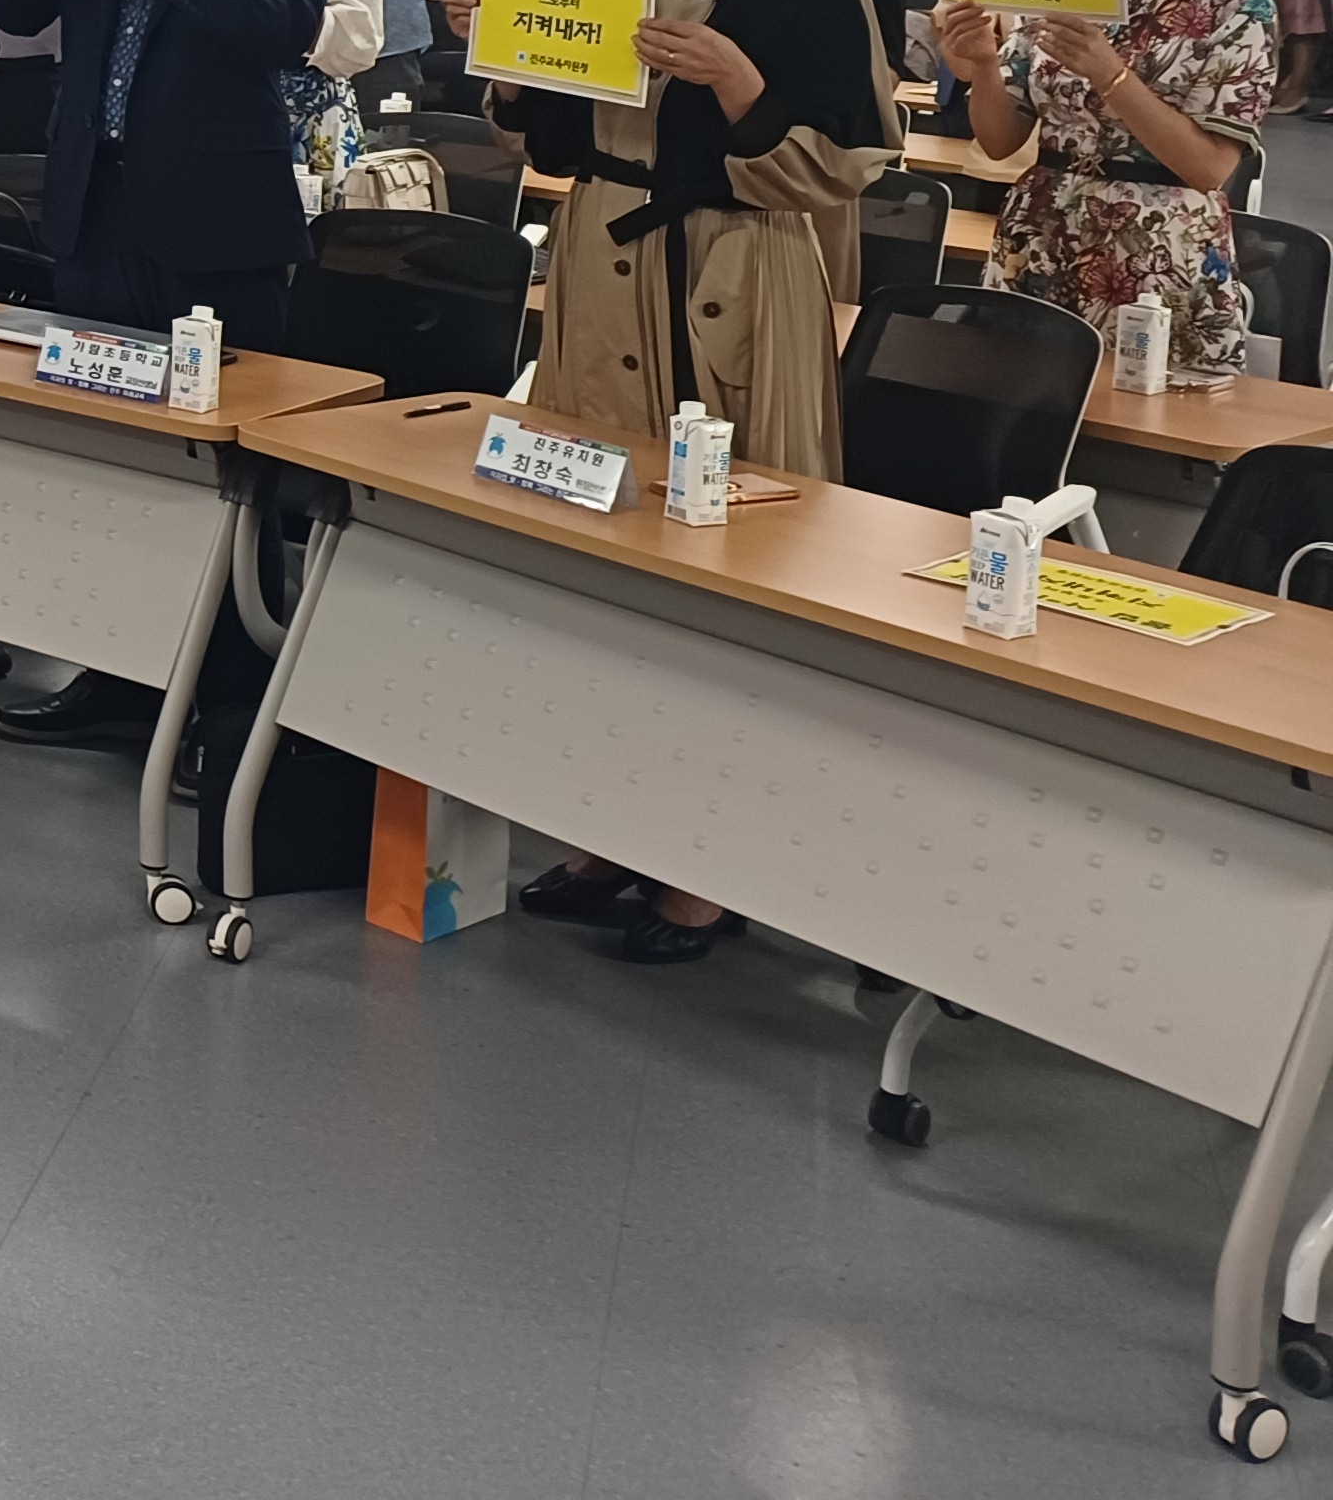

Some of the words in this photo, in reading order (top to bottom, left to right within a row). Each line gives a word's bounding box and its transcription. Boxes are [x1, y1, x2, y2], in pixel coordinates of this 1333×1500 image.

[513, 12, 602, 45] 지켜내자!
[530, 54, 588, 73] 진주교육지원청
[188, 347, 202, 365] 물
[1120, 347, 1148, 361] WATER
[68, 358, 123, 383] 노성훈
[175, 363, 200, 377] WATER
[533, 437, 605, 467] 진주유치원
[511, 453, 573, 486] 최창숙
[989, 551, 1008, 575] 물
[971, 568, 1005, 591] WATER
